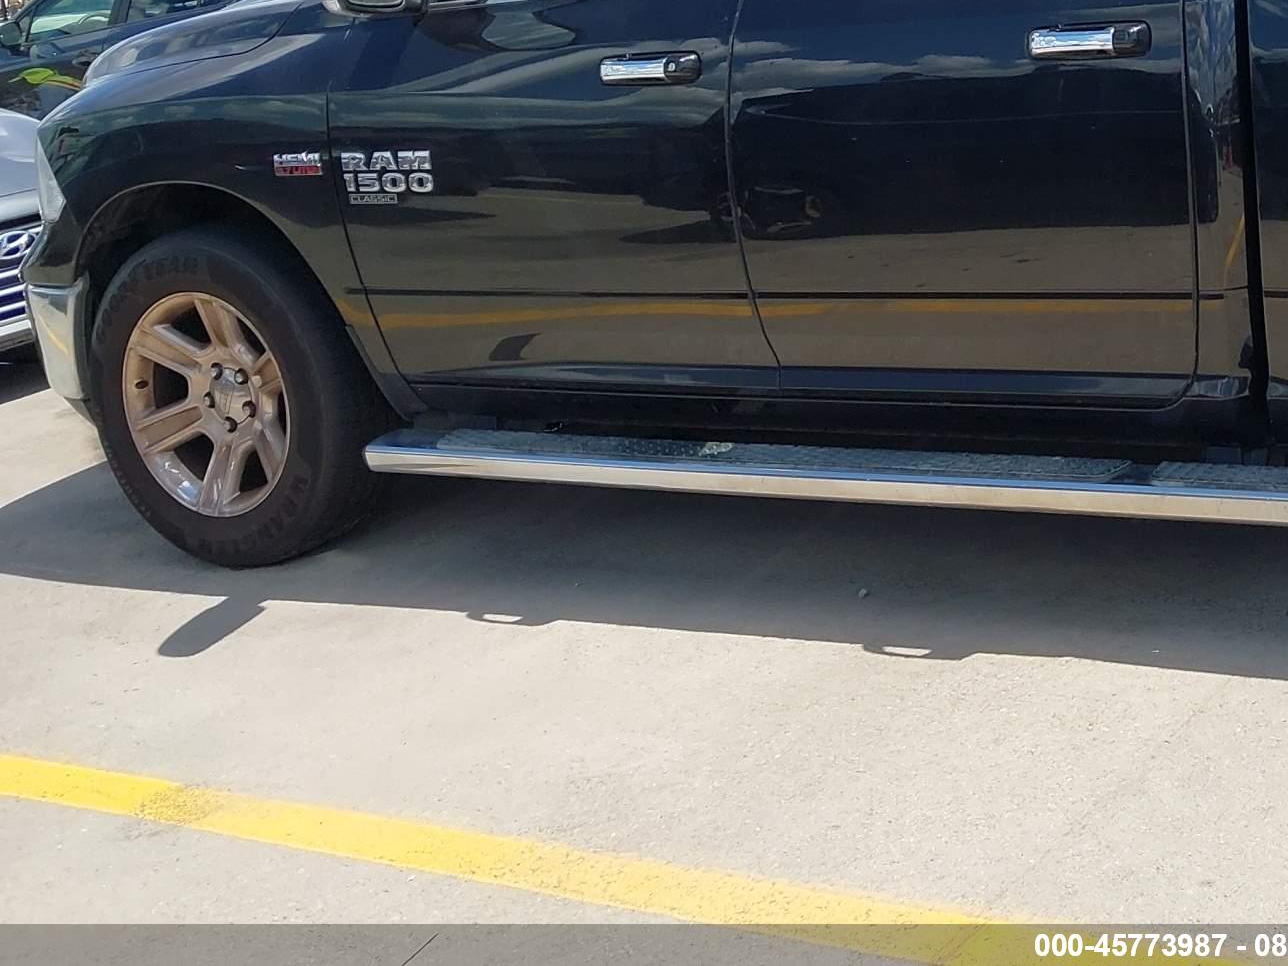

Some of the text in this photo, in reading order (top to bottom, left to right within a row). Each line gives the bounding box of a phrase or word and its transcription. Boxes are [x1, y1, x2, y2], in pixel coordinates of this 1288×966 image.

[273, 152, 321, 165] HEMI
[341, 151, 432, 171] RAM
[343, 172, 434, 193] 1500
[351, 194, 397, 203] CLASSIC
